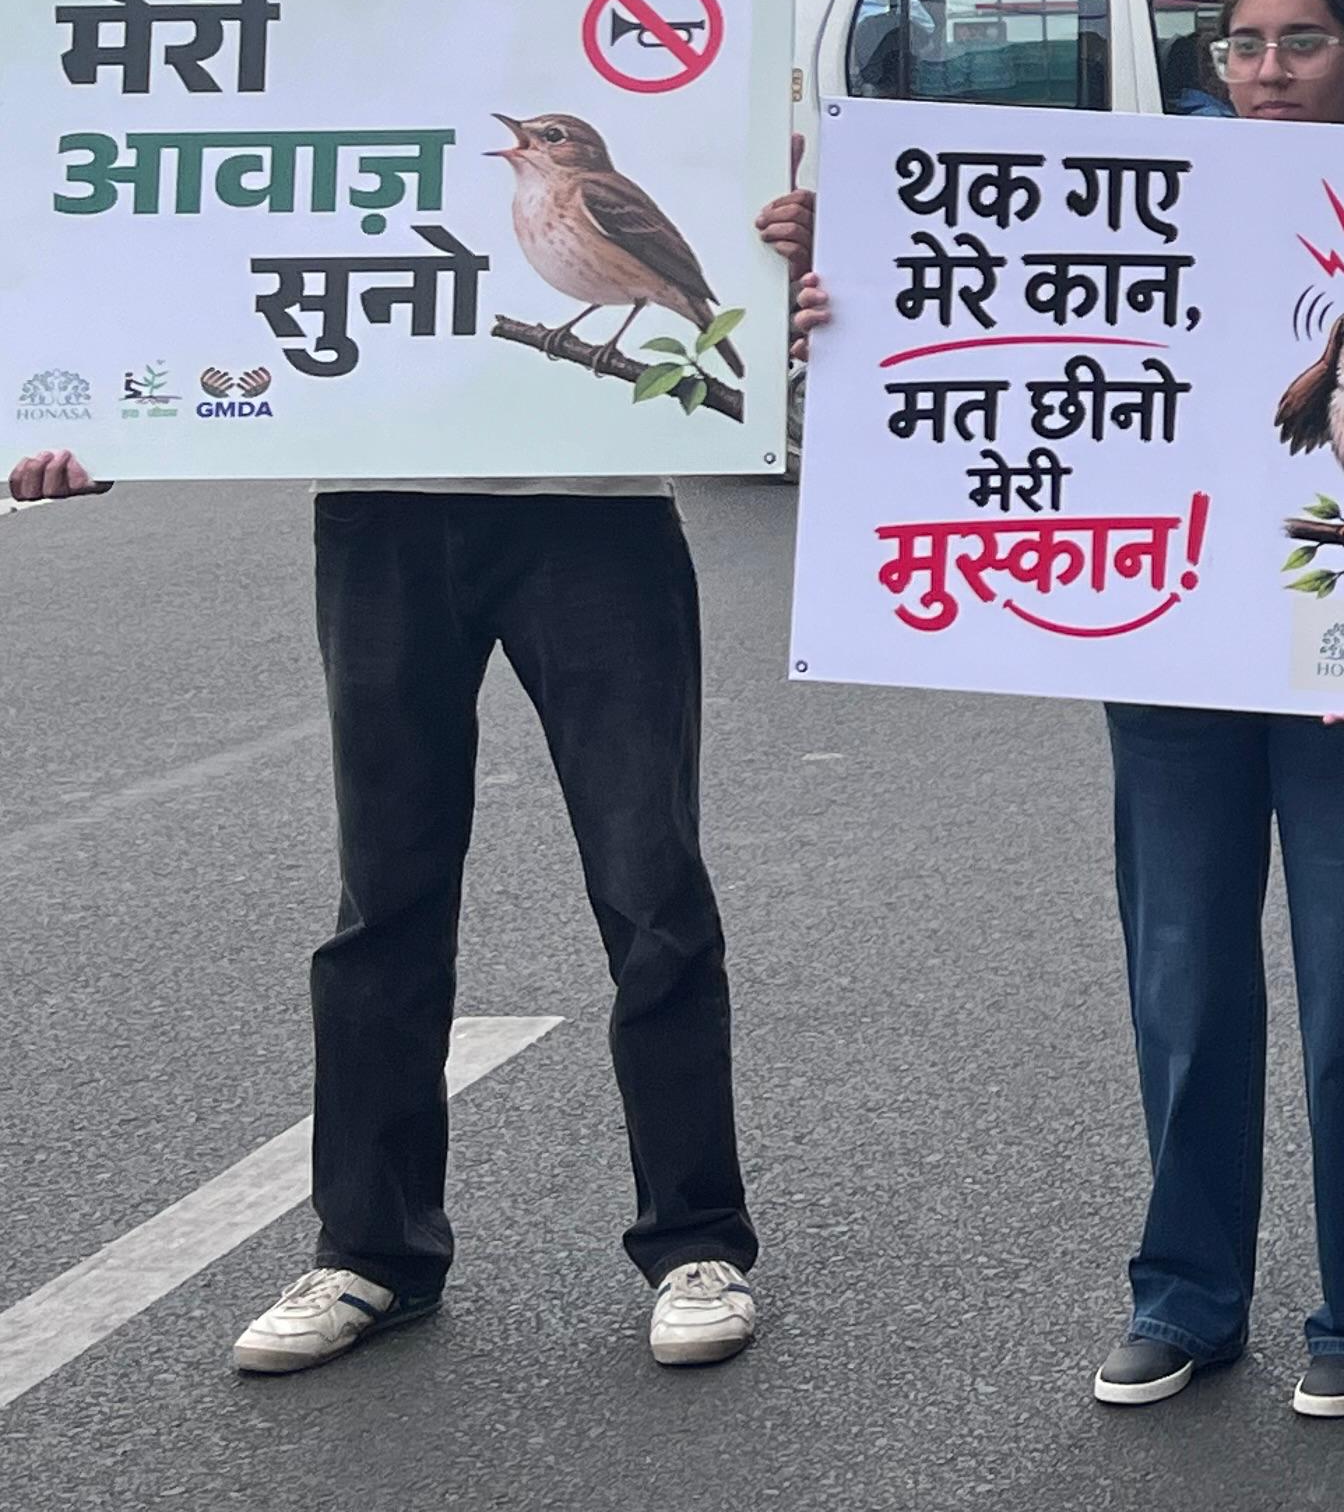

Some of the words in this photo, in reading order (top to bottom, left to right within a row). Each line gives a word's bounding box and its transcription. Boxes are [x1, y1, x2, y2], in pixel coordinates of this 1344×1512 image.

[54, 129, 456, 235] आवाज़
[896, 148, 1046, 229] थक
[1062, 157, 1192, 244] गए
[251, 225, 490, 377] सुनो
[893, 232, 1007, 329] मेरे
[1021, 254, 1200, 331] कान,
[17, 407, 92, 420] HONASA
[196, 402, 273, 418] GMDA
[885, 381, 1010, 443] मत
[1025, 355, 1191, 443] छीनो
[966, 447, 1072, 512] मेरी
[876, 491, 1209, 633] मुस्कान!
